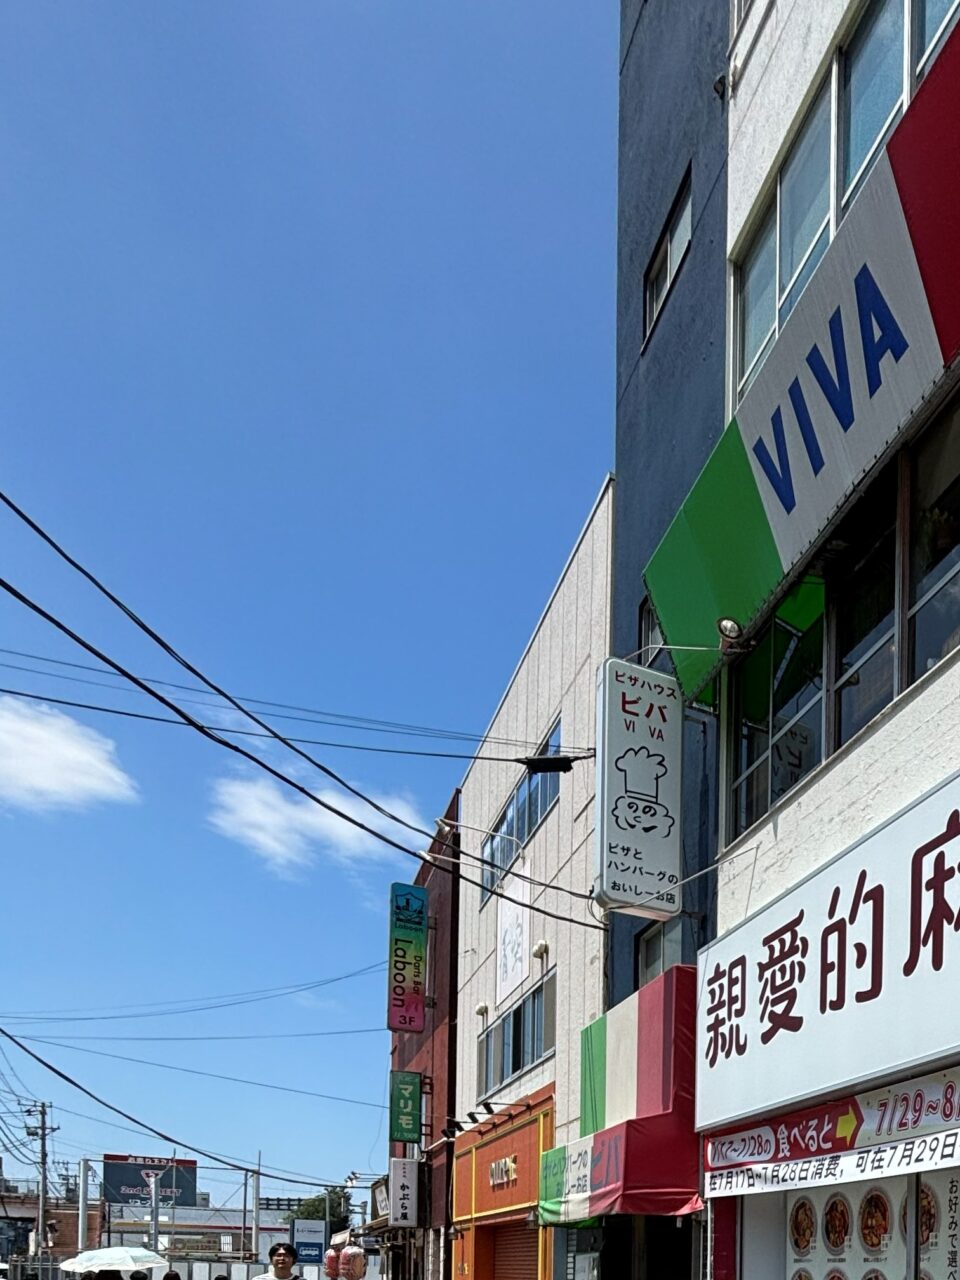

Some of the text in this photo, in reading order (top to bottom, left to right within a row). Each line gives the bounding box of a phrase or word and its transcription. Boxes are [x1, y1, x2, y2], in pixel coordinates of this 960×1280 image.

[752, 262, 909, 516] VIVA
[621, 691, 667, 723] ビバ
[607, 859, 678, 885] ハンバーグの
[611, 880, 676, 905] おいしーお店
[392, 938, 413, 1009] Laboon
[413, 955, 422, 995] Darts Bar
[399, 1015, 416, 1025] 3F
[399, 1084, 413, 1129] マリモ
[777, 1114, 833, 1159] 食べると
[400, 1182, 409, 1221] かぶら屋
